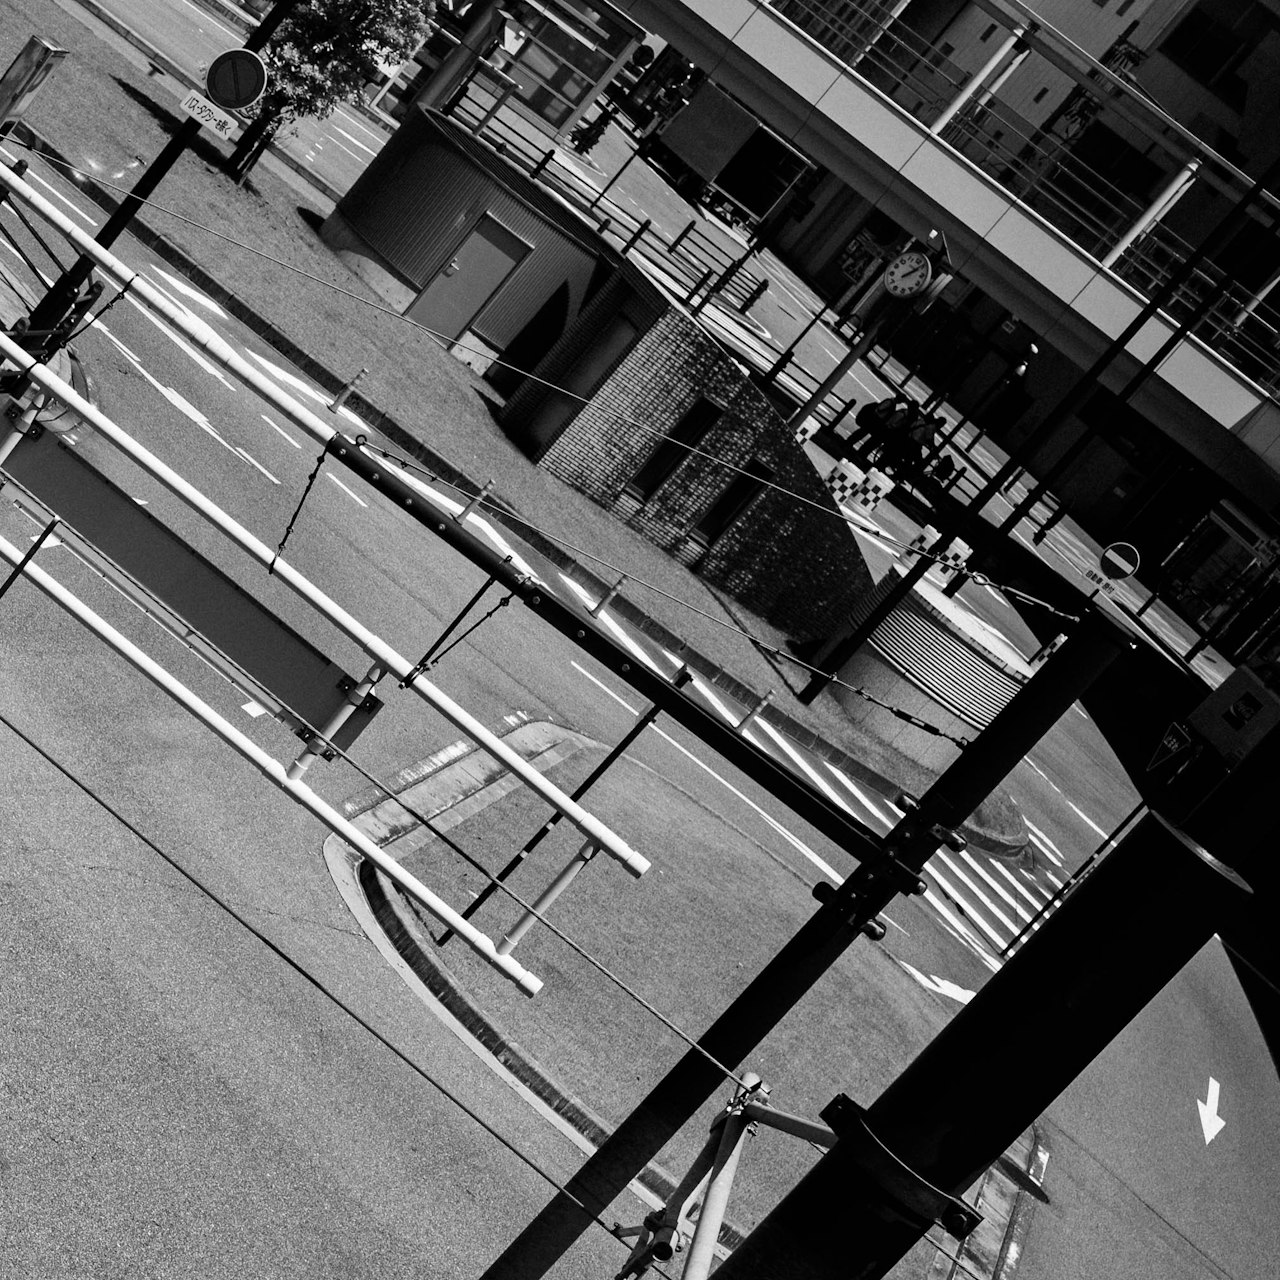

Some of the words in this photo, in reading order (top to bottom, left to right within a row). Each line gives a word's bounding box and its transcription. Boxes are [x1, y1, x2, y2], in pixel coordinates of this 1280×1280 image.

[185, 96, 231, 135] バス・タクシーを除く
